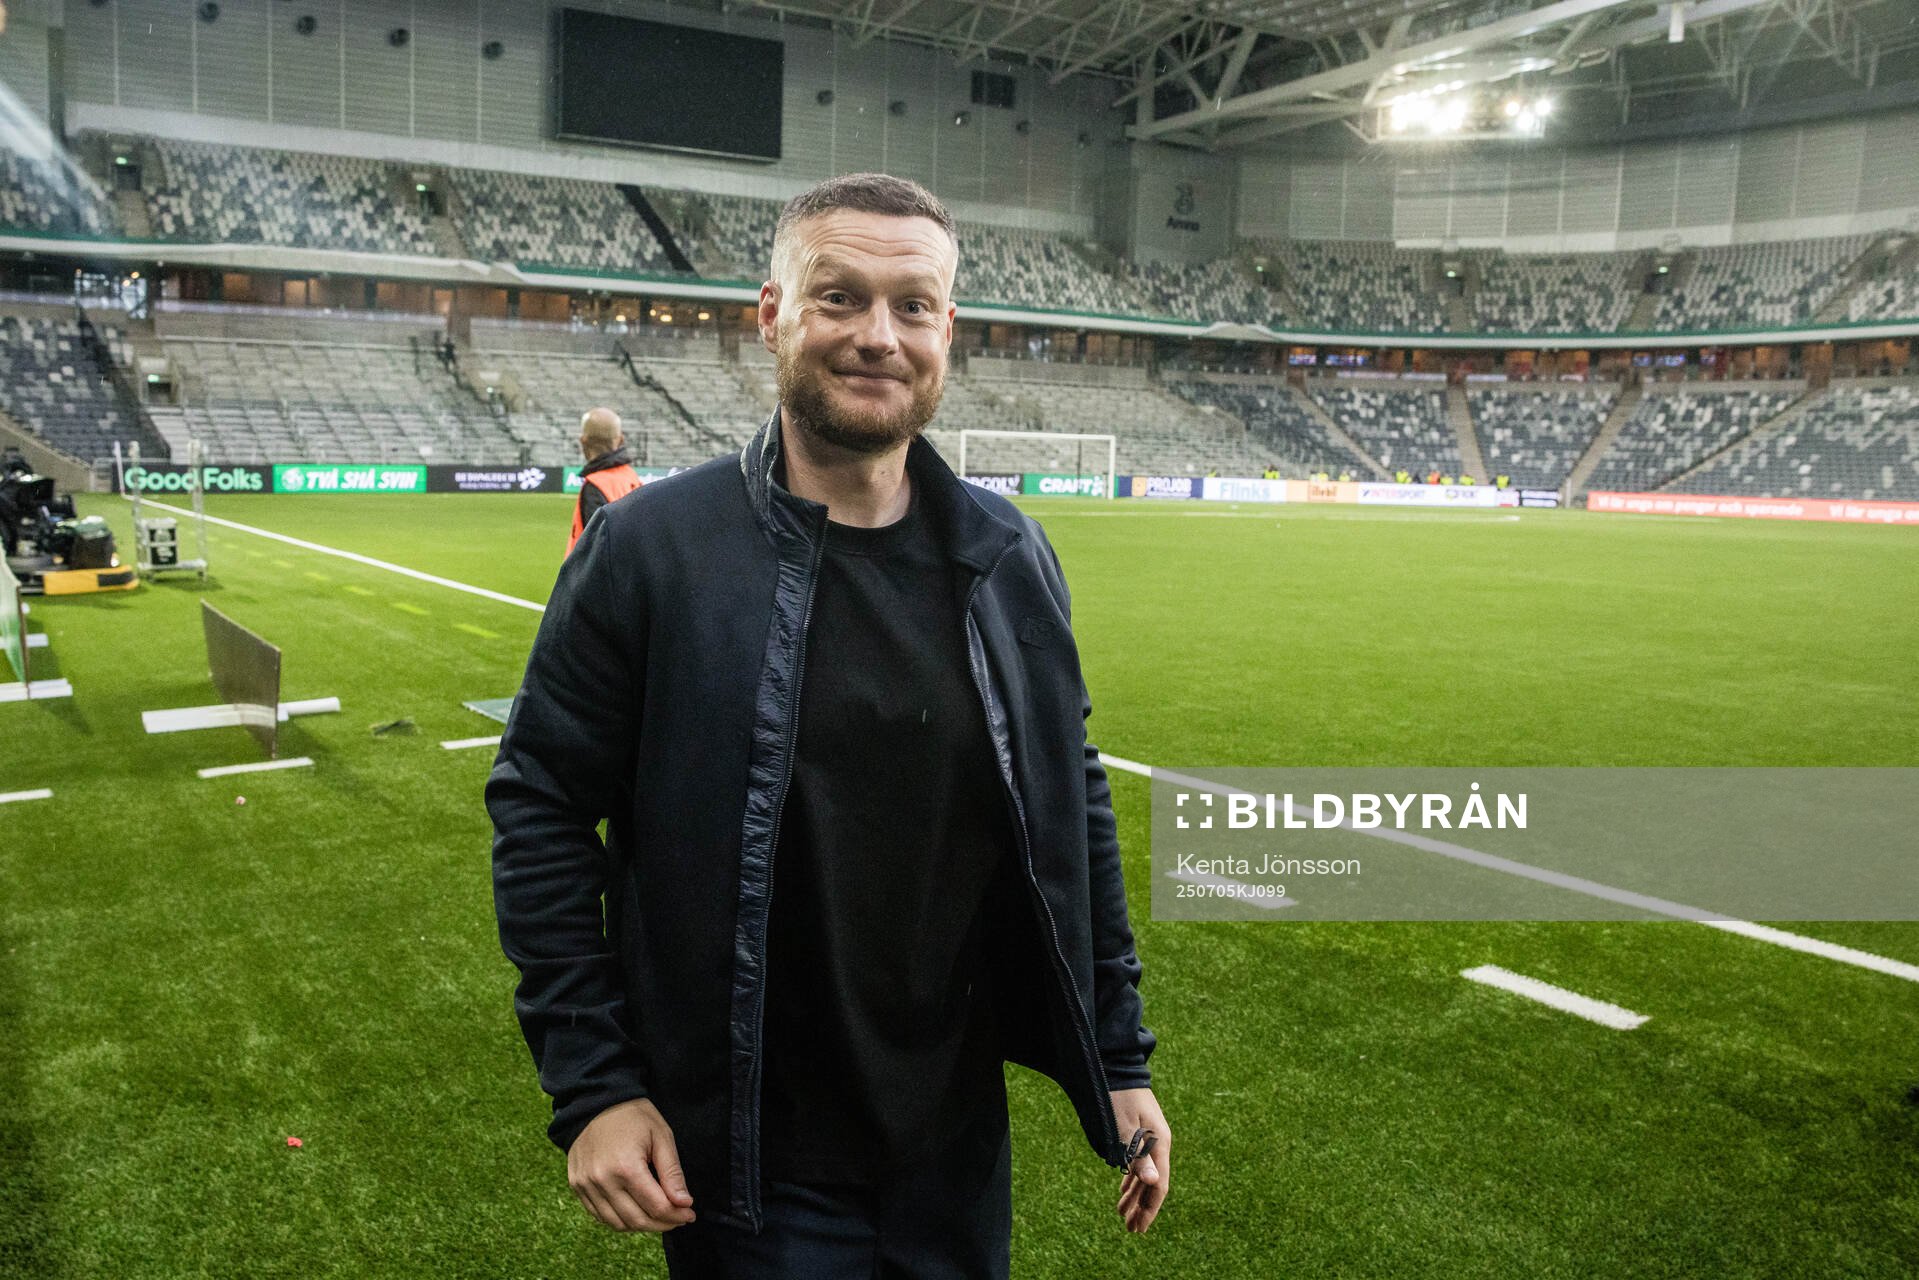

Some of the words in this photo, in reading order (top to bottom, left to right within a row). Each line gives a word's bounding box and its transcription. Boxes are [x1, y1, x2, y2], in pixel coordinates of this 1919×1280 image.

[203, 467, 263, 491] Folks
[1220, 482, 1270, 499] Flinks
[1718, 501, 1742, 513] och
[1744, 503, 1803, 517] sparande
